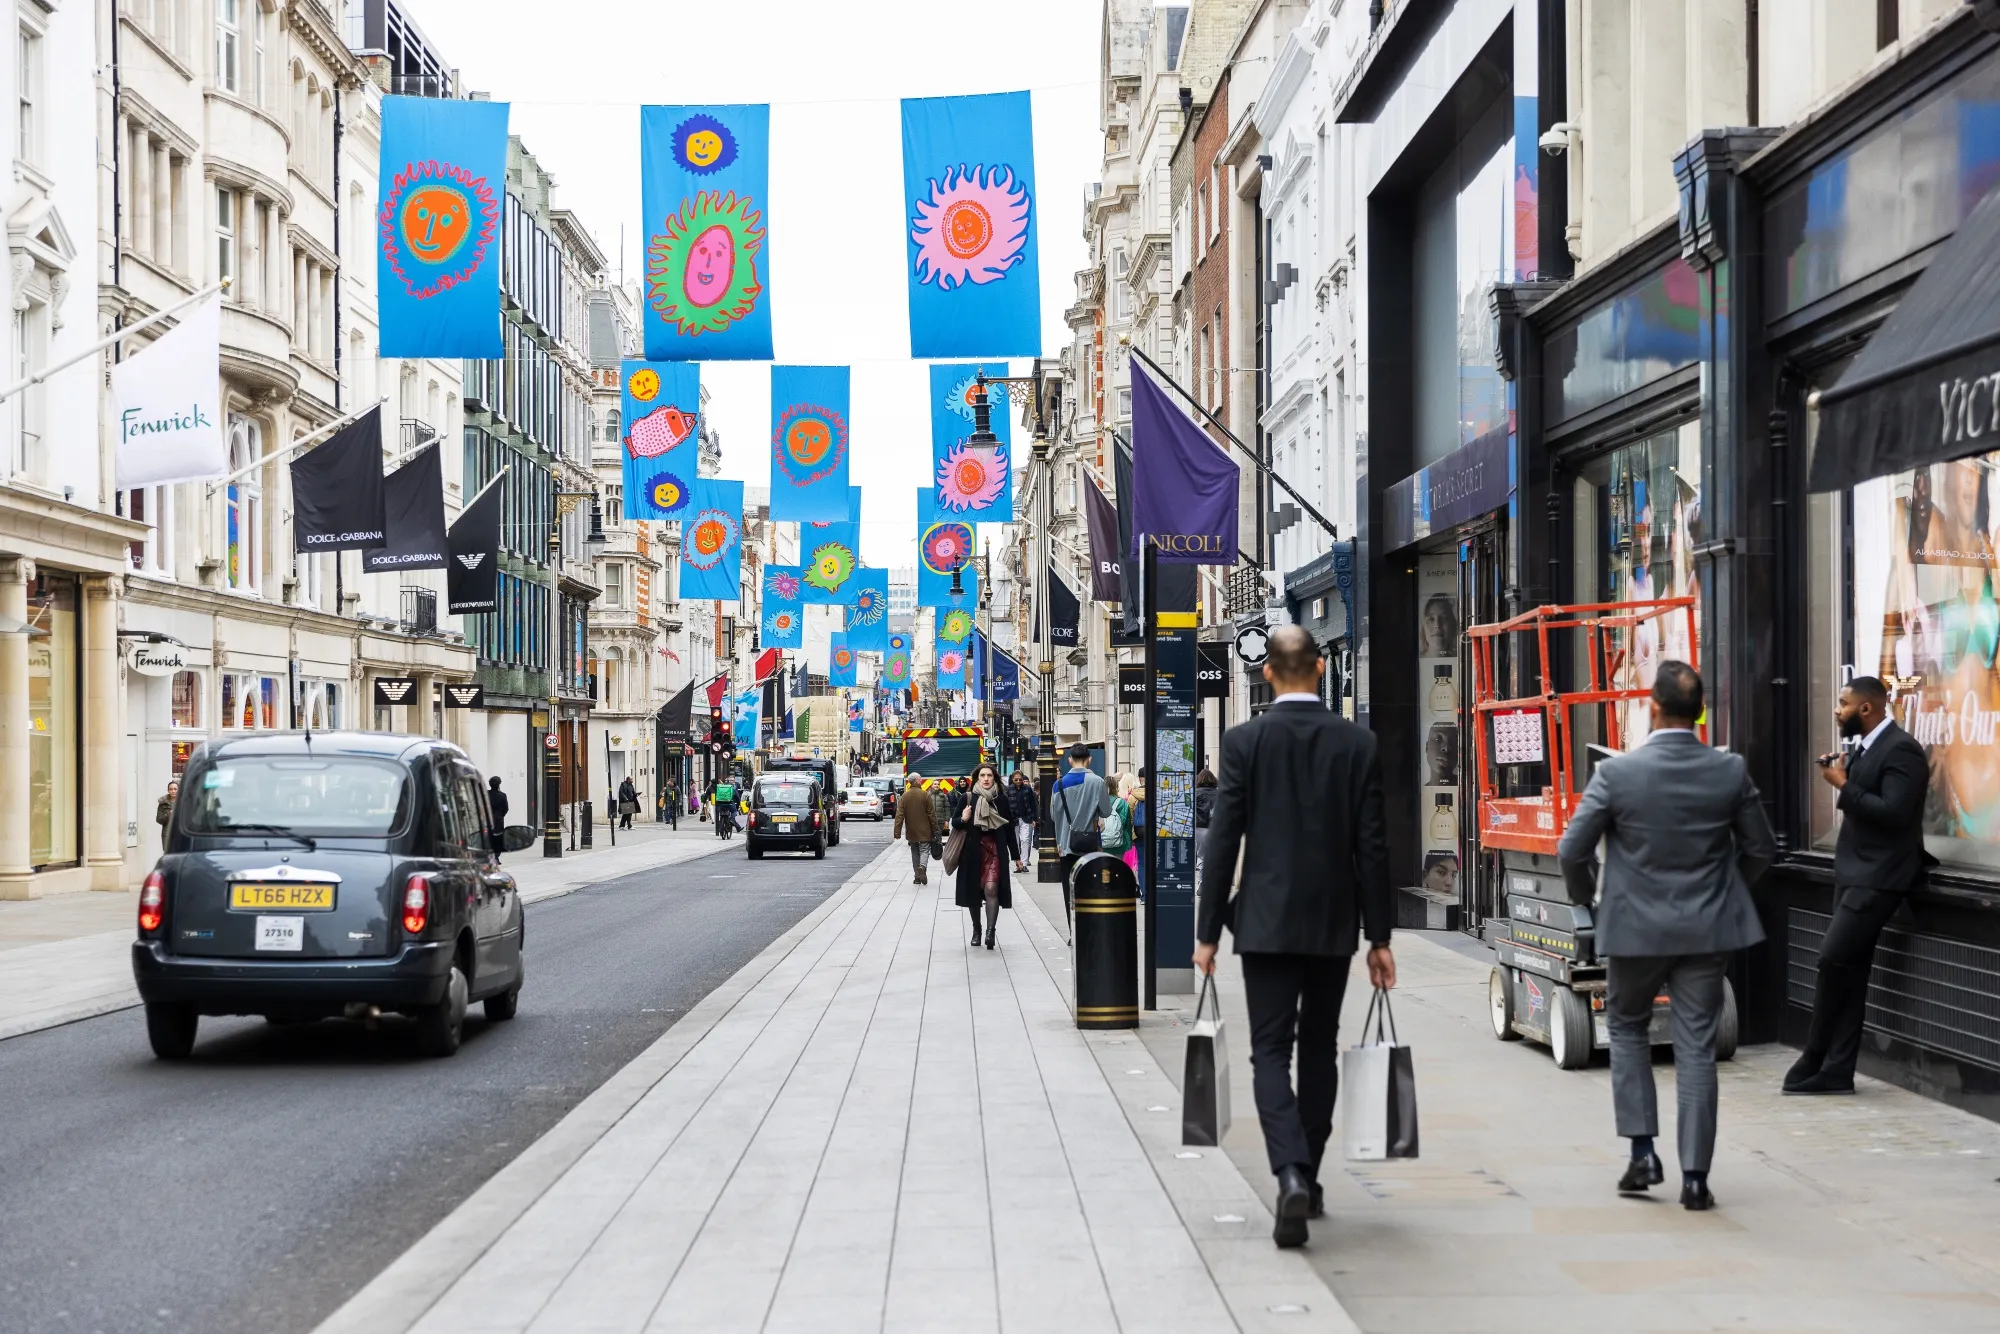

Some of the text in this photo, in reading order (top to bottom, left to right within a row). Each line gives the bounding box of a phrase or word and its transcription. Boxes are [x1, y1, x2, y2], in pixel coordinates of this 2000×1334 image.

[121, 404, 211, 444] Fenwick
[1456, 462, 1484, 500] SECRET
[307, 534, 336, 544] DOLCE
[340, 531, 384, 541] GABBANA
[1148, 534, 1222, 552] NICOLI
[372, 556, 398, 565] DOLCE
[402, 553, 443, 563] GABBANA
[1051, 627, 1074, 637] CORE
[134, 649, 184, 669] Fenwick
[1197, 670, 1222, 680] OSS
[1124, 684, 1146, 692] BOSS
[1902, 689, 1956, 750] That's
[241, 888, 324, 903] LT66 HZX
[265, 929, 294, 937] 27310
